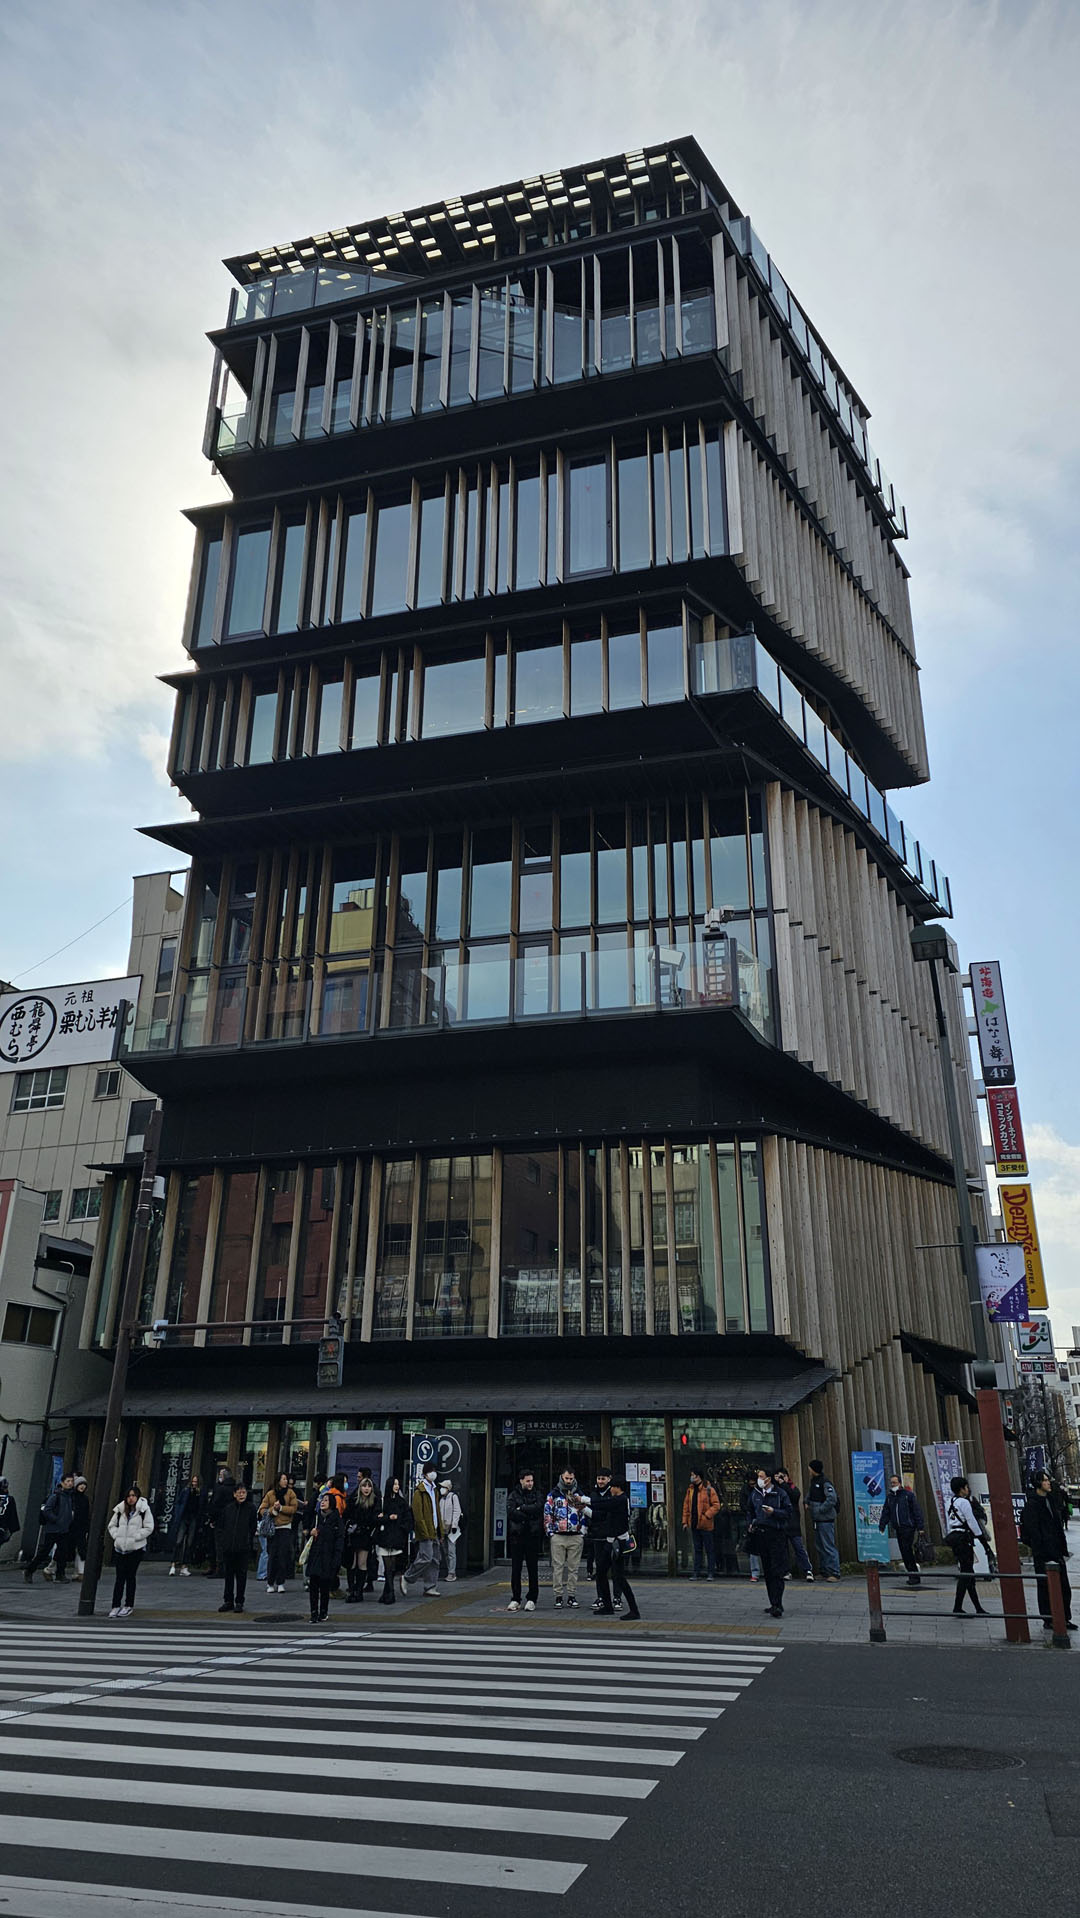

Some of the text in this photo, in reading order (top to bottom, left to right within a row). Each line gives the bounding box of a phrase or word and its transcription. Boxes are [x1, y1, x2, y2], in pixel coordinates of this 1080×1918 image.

[979, 966, 994, 999] 北海道
[64, 989, 95, 1006] 元祖
[8, 1005, 26, 1057] 西むら
[985, 1016, 1005, 1062] はなの舞
[989, 1067, 1009, 1079] 4F
[995, 1103, 1010, 1151] コミックカフェ
[1000, 1164, 1025, 1172] 3F受付
[1026, 1259, 1035, 1284] COFFEE
